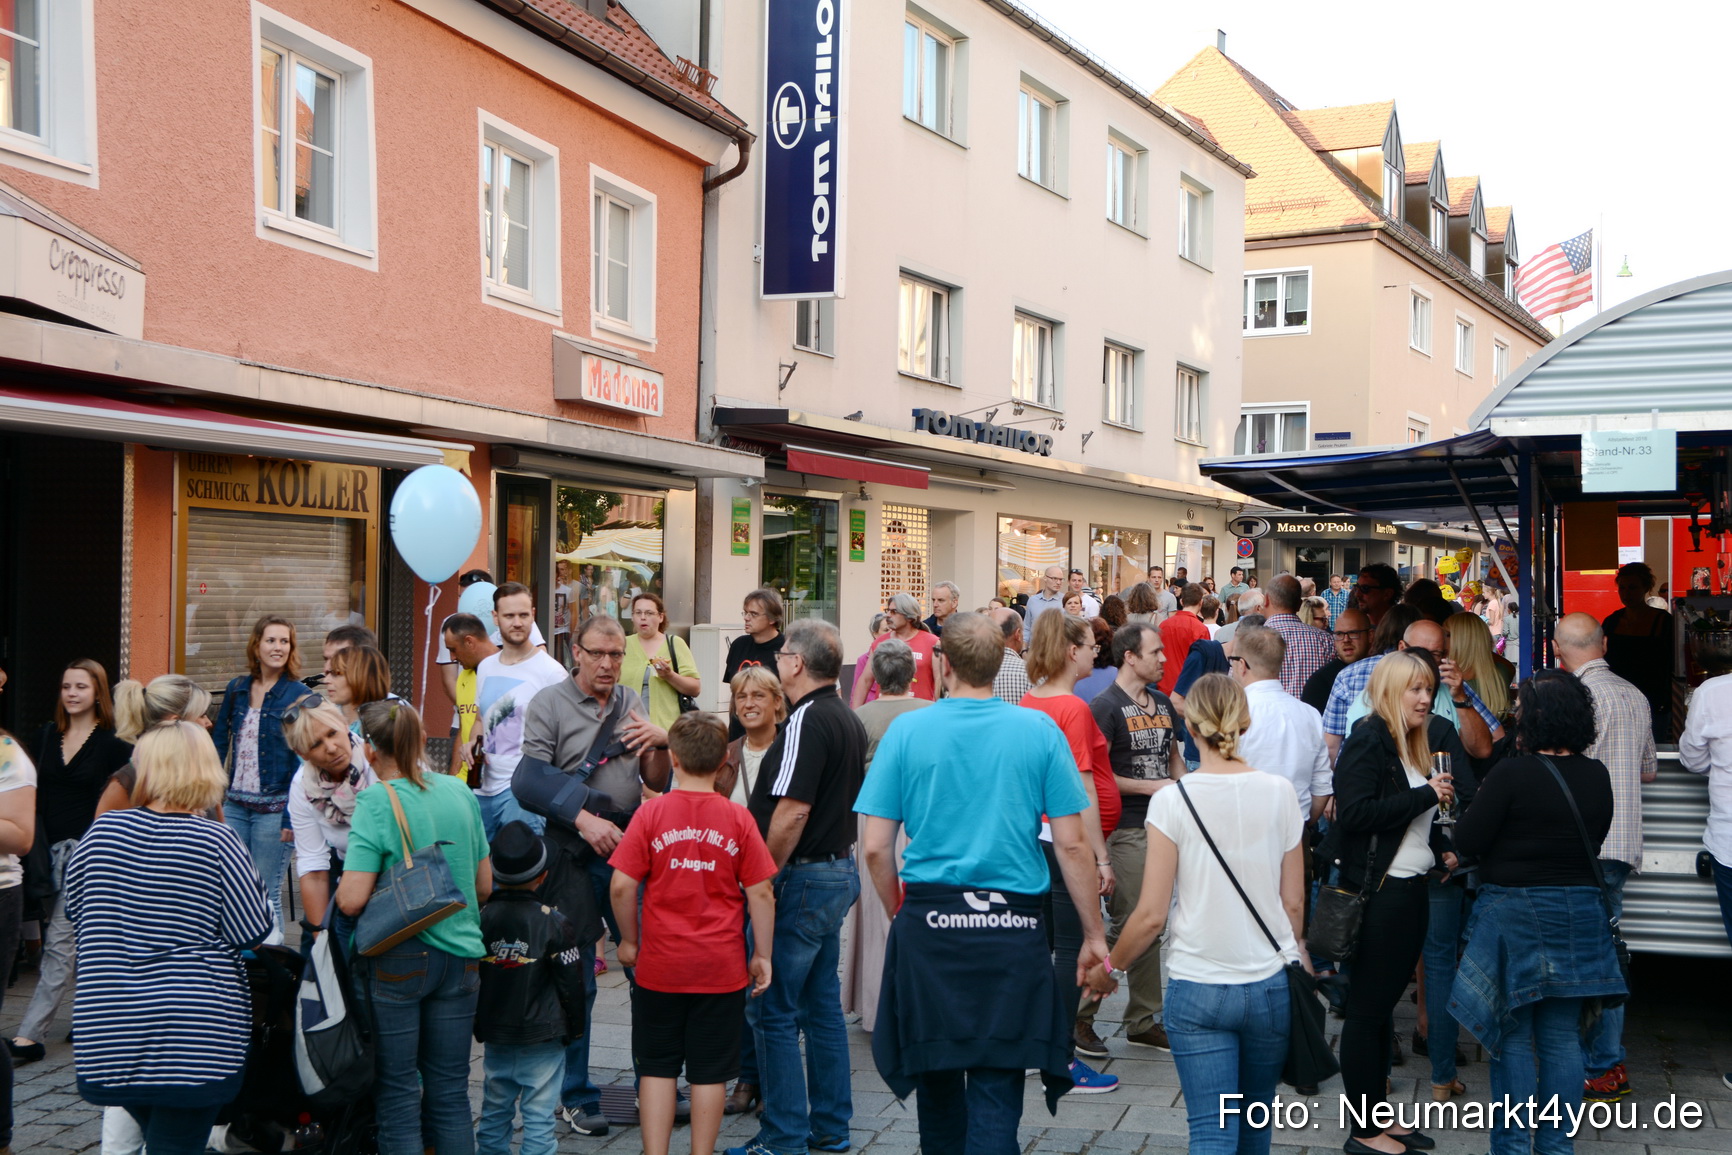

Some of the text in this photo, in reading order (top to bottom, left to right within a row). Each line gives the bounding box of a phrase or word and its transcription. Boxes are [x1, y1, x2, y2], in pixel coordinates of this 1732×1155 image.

[812, 0, 834, 262] TOM TAILO
[49, 238, 125, 300] Creppresso
[587, 356, 659, 412] Madonna
[912, 407, 1054, 457] TOM TAILOR
[187, 453, 233, 475] UHREN
[187, 478, 250, 502] SCHMUCK
[255, 458, 370, 513] KOLLER
[1276, 522, 1356, 533] Marc O'Polo
[1129, 728, 1158, 742] THRILLS
[926, 909, 1038, 930] Commodore
[496, 948, 521, 961] 95
